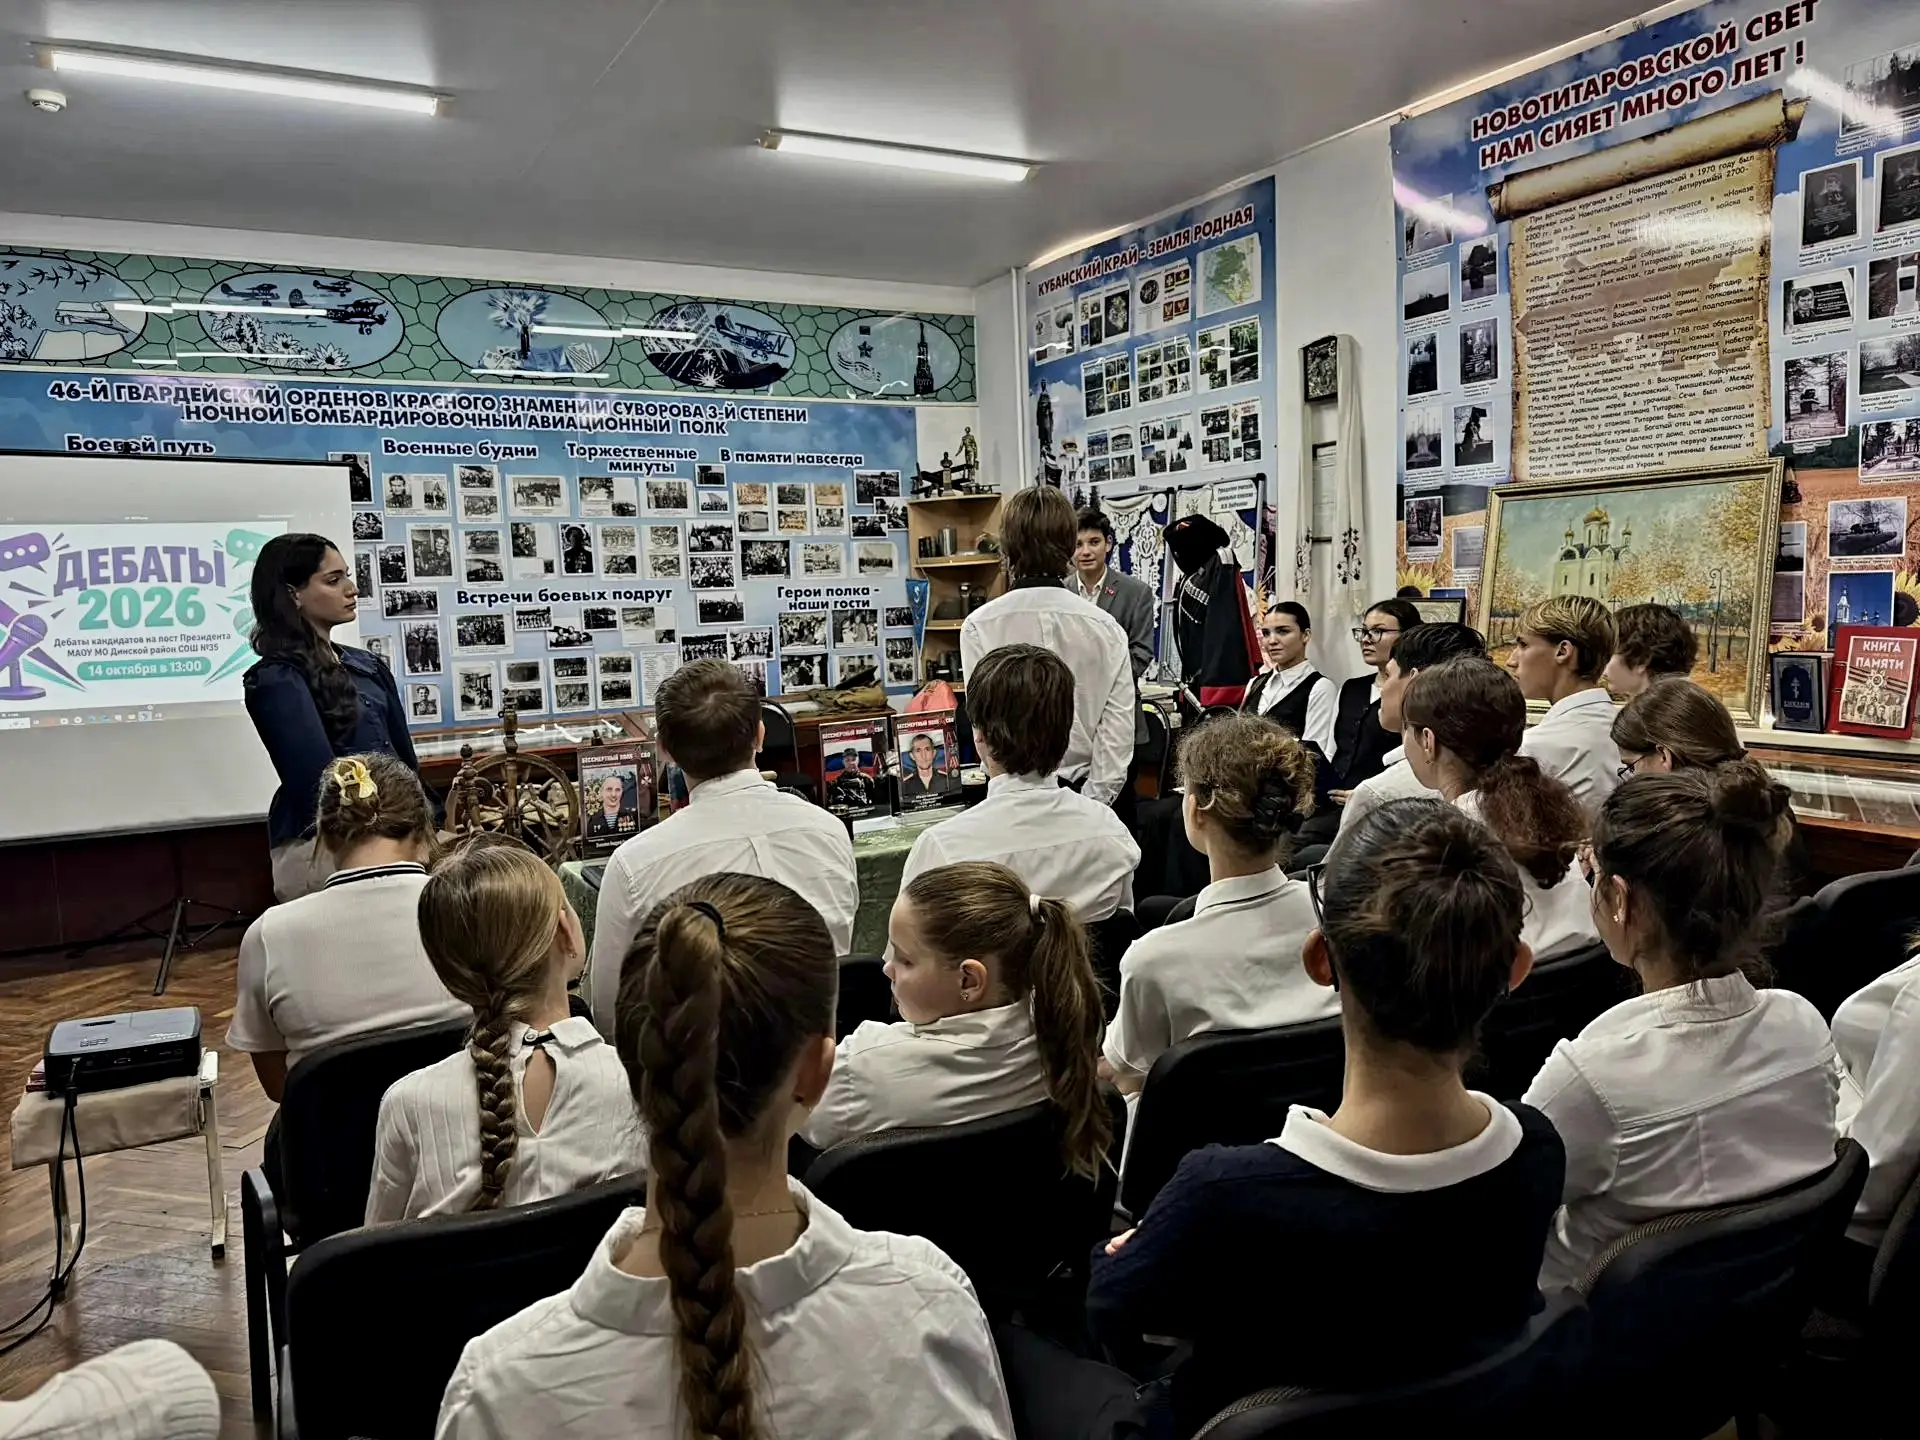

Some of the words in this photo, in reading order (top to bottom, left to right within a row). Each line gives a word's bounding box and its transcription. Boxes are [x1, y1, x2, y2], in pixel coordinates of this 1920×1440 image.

[1473, 19, 1737, 139] НОВОТИТАРОВСКОЙ
[1745, 0, 1818, 41] СВЕТ
[1480, 137, 1532, 169] НАМ
[1540, 105, 1614, 148] СИЯЕТ
[1621, 70, 1724, 121] МНОГО
[1731, 46, 1786, 86] ЛЕТ
[1579, 197, 1605, 210] курганов
[1628, 172, 1686, 196] Новотитаровской
[1698, 163, 1715, 175] 1970
[1718, 160, 1735, 171] году
[1738, 152, 1754, 164] был
[1560, 212, 1574, 223] слой
[1579, 196, 1632, 219] Новотитаровской
[1637, 189, 1667, 203] культуры
[1726, 164, 1748, 177] 2700-
[1716, 196, 1740, 209] войска
[1609, 210, 1650, 229] Титаровской
[1659, 199, 1701, 216] встречаются
[1038, 260, 1102, 296] КУБАНСКИЙ
[1103, 245, 1138, 273] КРАЙ
[1147, 231, 1191, 257] ЗЕМЛЯ
[1193, 206, 1253, 241] РОДНАЯ
[1600, 263, 1627, 275] Динской
[1644, 267, 1654, 275] где
[1657, 261, 1681, 273] какому
[1684, 255, 1709, 267] куреню
[1613, 298, 1636, 309] Атаман
[1642, 290, 1670, 303] кошевой
[1708, 276, 1741, 291] бригадир
[1611, 314, 1645, 327] Войсковой
[1702, 295, 1753, 311] подполковник
[1613, 304, 1647, 318] Войсковой
[1673, 324, 1689, 334] 1788
[1712, 313, 1753, 329] образовала
[1689, 331, 1714, 340] южных
[1723, 322, 1753, 336] рубежей
[1662, 340, 1718, 356] разрушительных
[1725, 332, 1753, 344] набегов
[1639, 355, 1674, 369] предгорий
[1681, 349, 1715, 363] Северного
[1729, 371, 1753, 383] Между
[1702, 386, 1716, 395] был
[1725, 383, 1753, 392] основан
[48, 379, 108, 401] 46-Й
[115, 381, 281, 406] ГВАРДЕЙСКИЙ
[286, 390, 388, 409] ОРДЕНОВ
[392, 394, 494, 411] КРАСНОГО
[502, 396, 589, 415] ЗНАМЕНИ
[594, 401, 608, 415] И
[613, 402, 704, 418] СУВОРОВА
[741, 406, 806, 422] СТЕПЕНИ
[1708, 404, 1744, 415] красавица
[186, 402, 285, 423] НОЧНОЙ
[291, 407, 522, 430] БОМБАРДИРОВОЧНЫЙ
[525, 411, 671, 434] АВИАЦИОННЫЙ
[679, 420, 728, 435] ПОЛК
[1644, 420, 1671, 430] Богатый
[1721, 412, 1753, 421] согласия
[1689, 424, 1742, 434] остановившись
[162, 440, 215, 456] путь
[383, 440, 474, 456] Военные
[478, 442, 537, 461] будни
[567, 443, 697, 461] Торжественные
[1625, 442, 1638, 450] Они
[1641, 440, 1677, 450] построили
[1680, 437, 1706, 446] первую
[1668, 446, 1705, 456] униженные
[1709, 440, 1740, 451] беженцы
[608, 460, 675, 475] минуты
[721, 451, 731, 463] В
[735, 453, 793, 466] памяти
[797, 454, 863, 467] навсегда
[53, 546, 226, 597] ДЕБАТЫ
[457, 590, 533, 605] Встречи
[538, 587, 607, 604] боевых
[612, 587, 672, 603] подруг
[777, 587, 823, 600] Герои
[827, 588, 870, 599] полка
[77, 586, 206, 630] 2026
[789, 600, 826, 611] наши
[830, 600, 870, 611] гости
[54, 637, 90, 648] Дебаты
[91, 636, 144, 646] кандидатов
[158, 635, 178, 643] пост
[180, 632, 231, 643] Президента
[1862, 640, 1901, 652] КНИГА
[67, 647, 92, 658] МАОУ
[94, 648, 109, 657] МО
[110, 646, 149, 657] Динской
[150, 646, 177, 656] район
[178, 645, 199, 653] СОШ
[88, 664, 102, 676] 14
[105, 662, 157, 675] октября
[160, 664, 168, 673] в
[170, 660, 202, 672] 13:00
[1855, 656, 1904, 670] ПАМЯТИ
